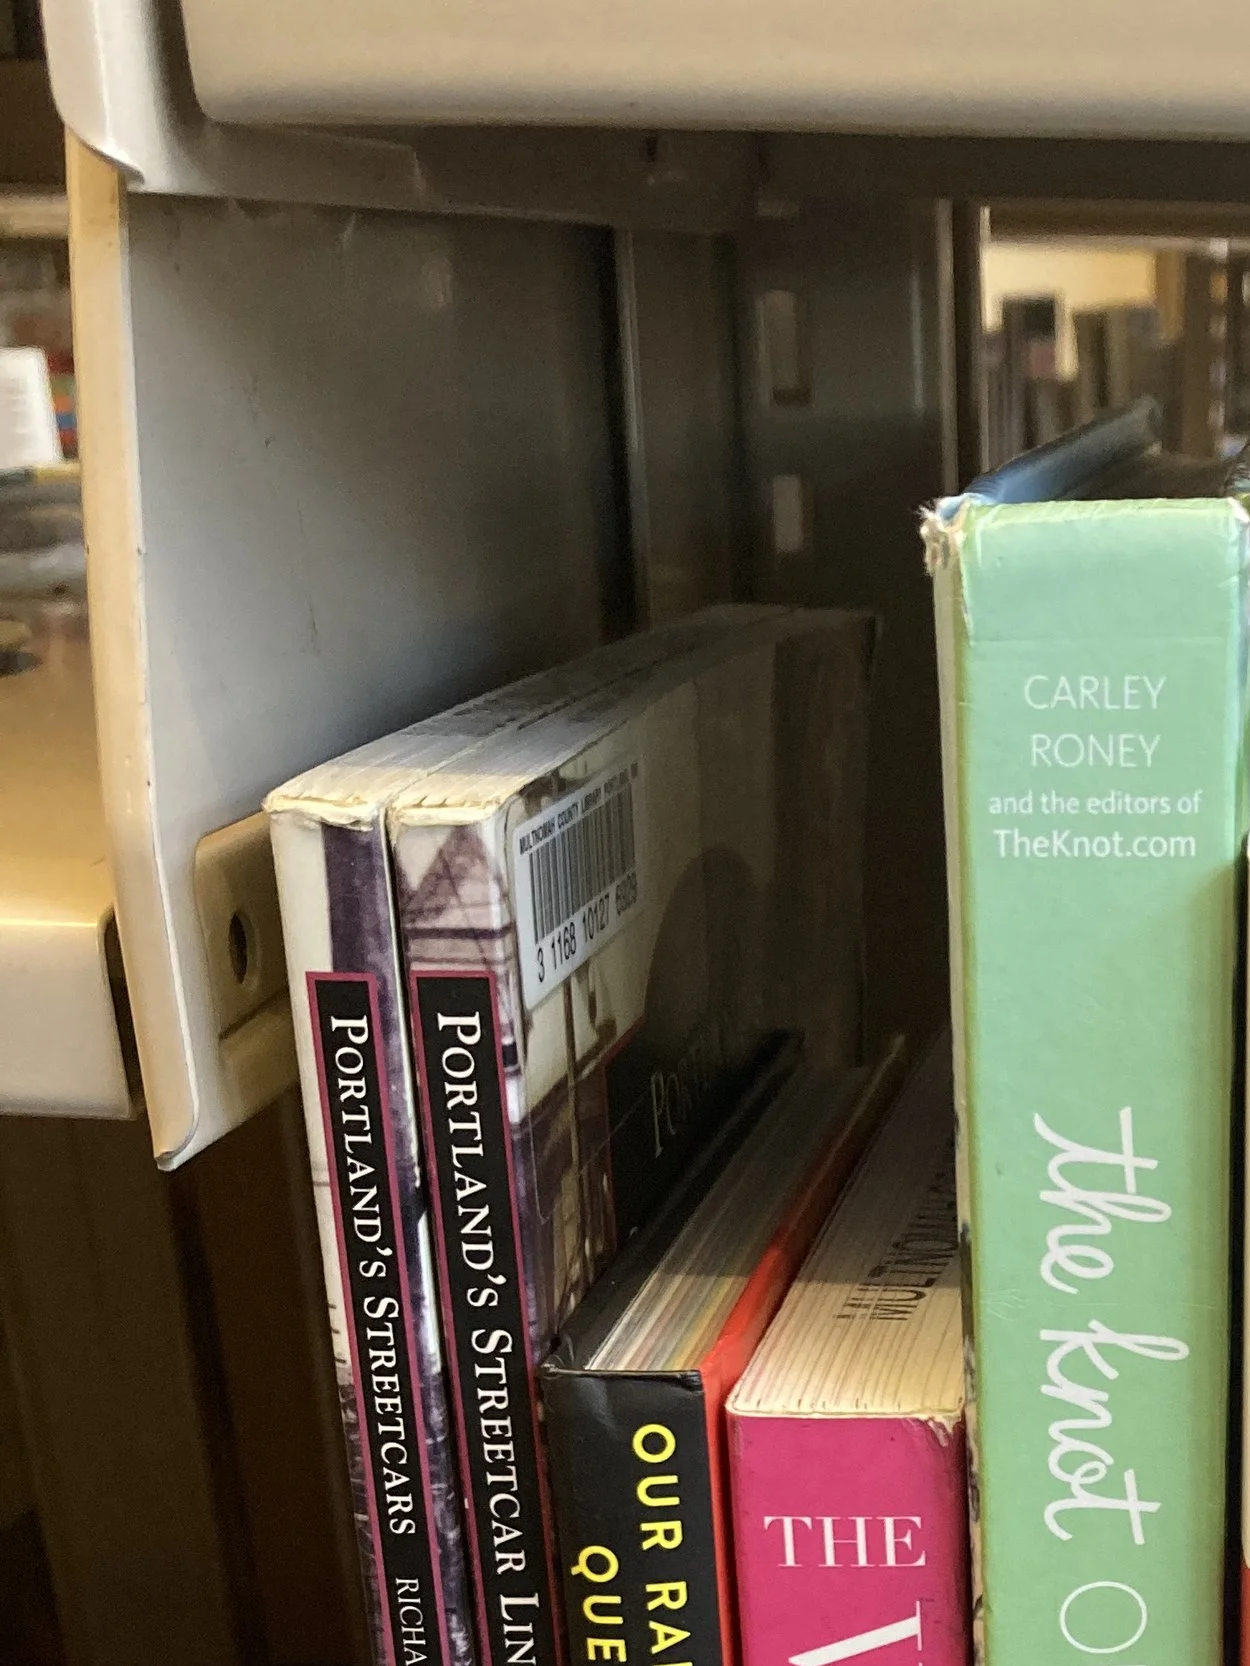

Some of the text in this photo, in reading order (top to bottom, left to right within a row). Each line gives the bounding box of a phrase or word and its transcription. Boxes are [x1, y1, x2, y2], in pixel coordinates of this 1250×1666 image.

[1023, 674, 1167, 711] CARLEY
[1030, 732, 1162, 768] RONEY
[988, 788, 1204, 815] and the editors of
[993, 828, 1197, 859] TheKnot.com
[537, 947, 546, 983] 3
[437, 1010, 505, 1308] PORTLAND'S
[1033, 1106, 1172, 1295] the
[330, 1013, 416, 1537] PORTLAND'S STREETCARS
[470, 1328, 526, 1575] STREETCAR
[1039, 1318, 1190, 1546] knot
[632, 1423, 683, 1551] OUR
[763, 1516, 926, 1567] THE
